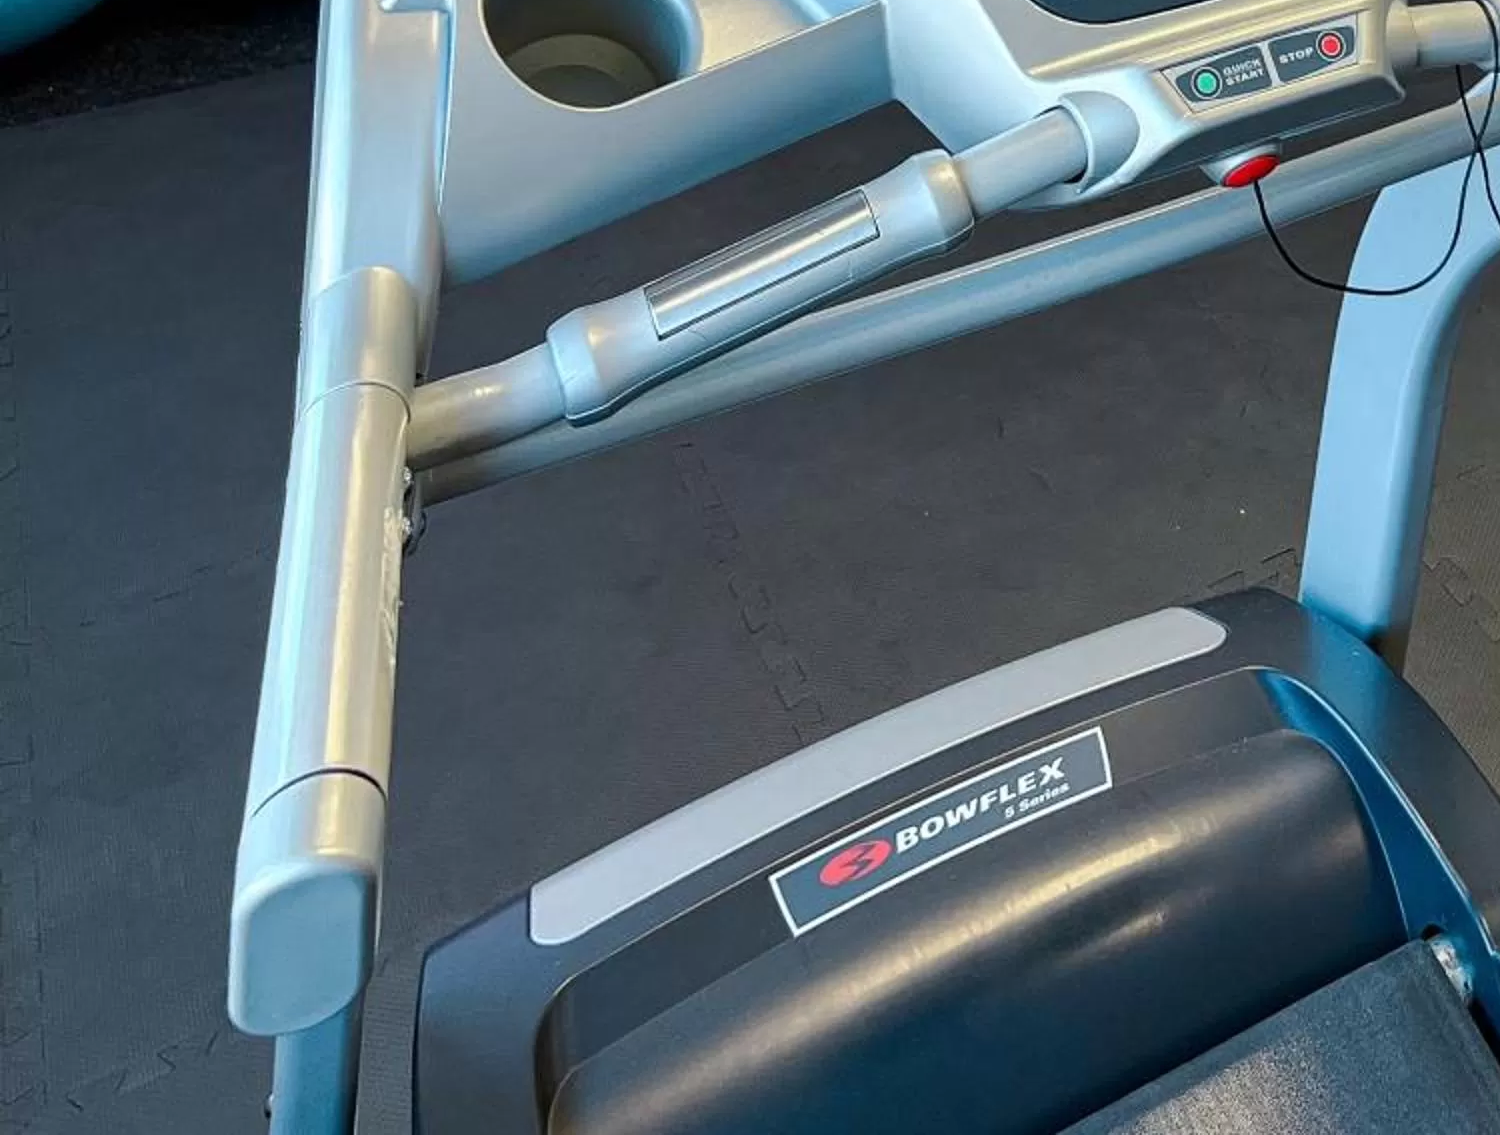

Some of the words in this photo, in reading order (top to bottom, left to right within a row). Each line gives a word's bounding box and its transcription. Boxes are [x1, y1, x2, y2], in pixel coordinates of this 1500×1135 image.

[1279, 46, 1314, 65] STOP
[1223, 58, 1262, 76] QUICK
[1225, 68, 1265, 87] START
[895, 756, 1066, 855] BOWFLEX
[1018, 782, 1071, 814] Series
